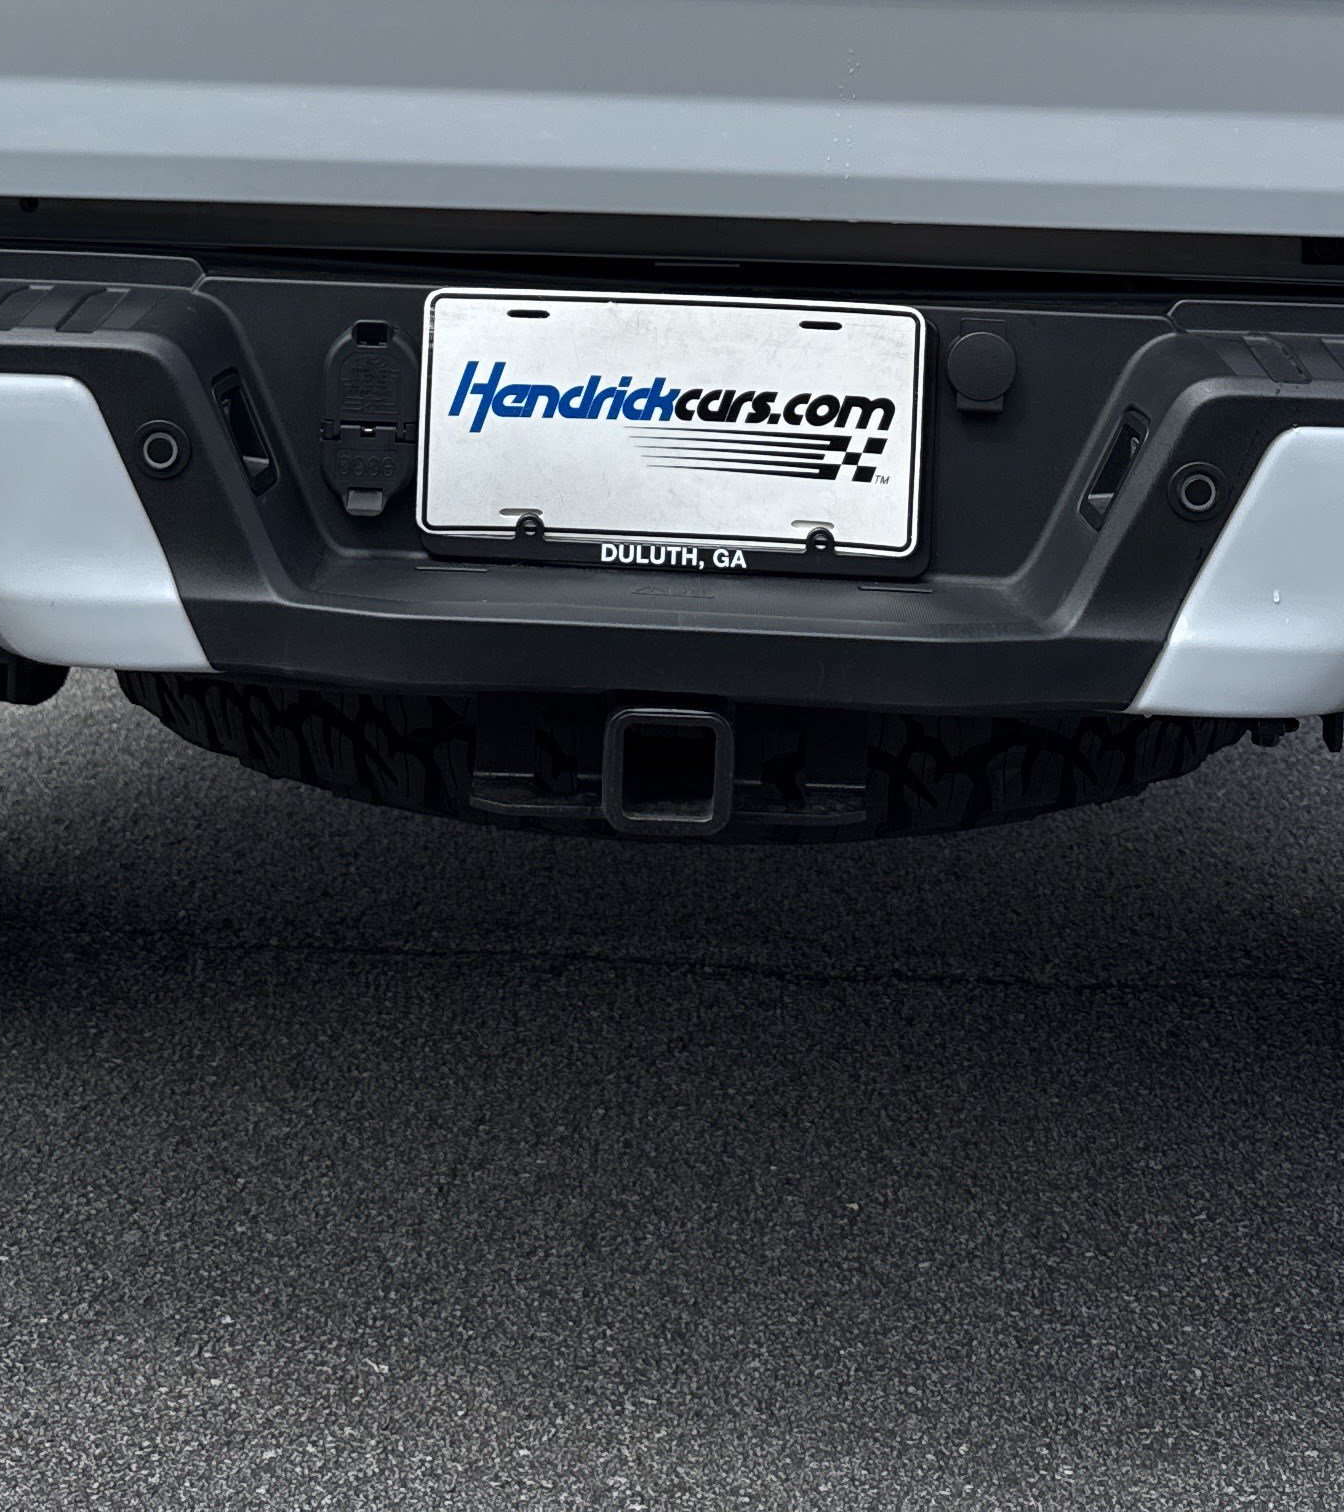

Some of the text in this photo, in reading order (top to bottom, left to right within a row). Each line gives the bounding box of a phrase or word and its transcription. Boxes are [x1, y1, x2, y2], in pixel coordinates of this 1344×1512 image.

[448, 360, 896, 434] Hendrickcars.com
[875, 474, 890, 485] TM
[600, 542, 747, 570] DULUTH, GA
